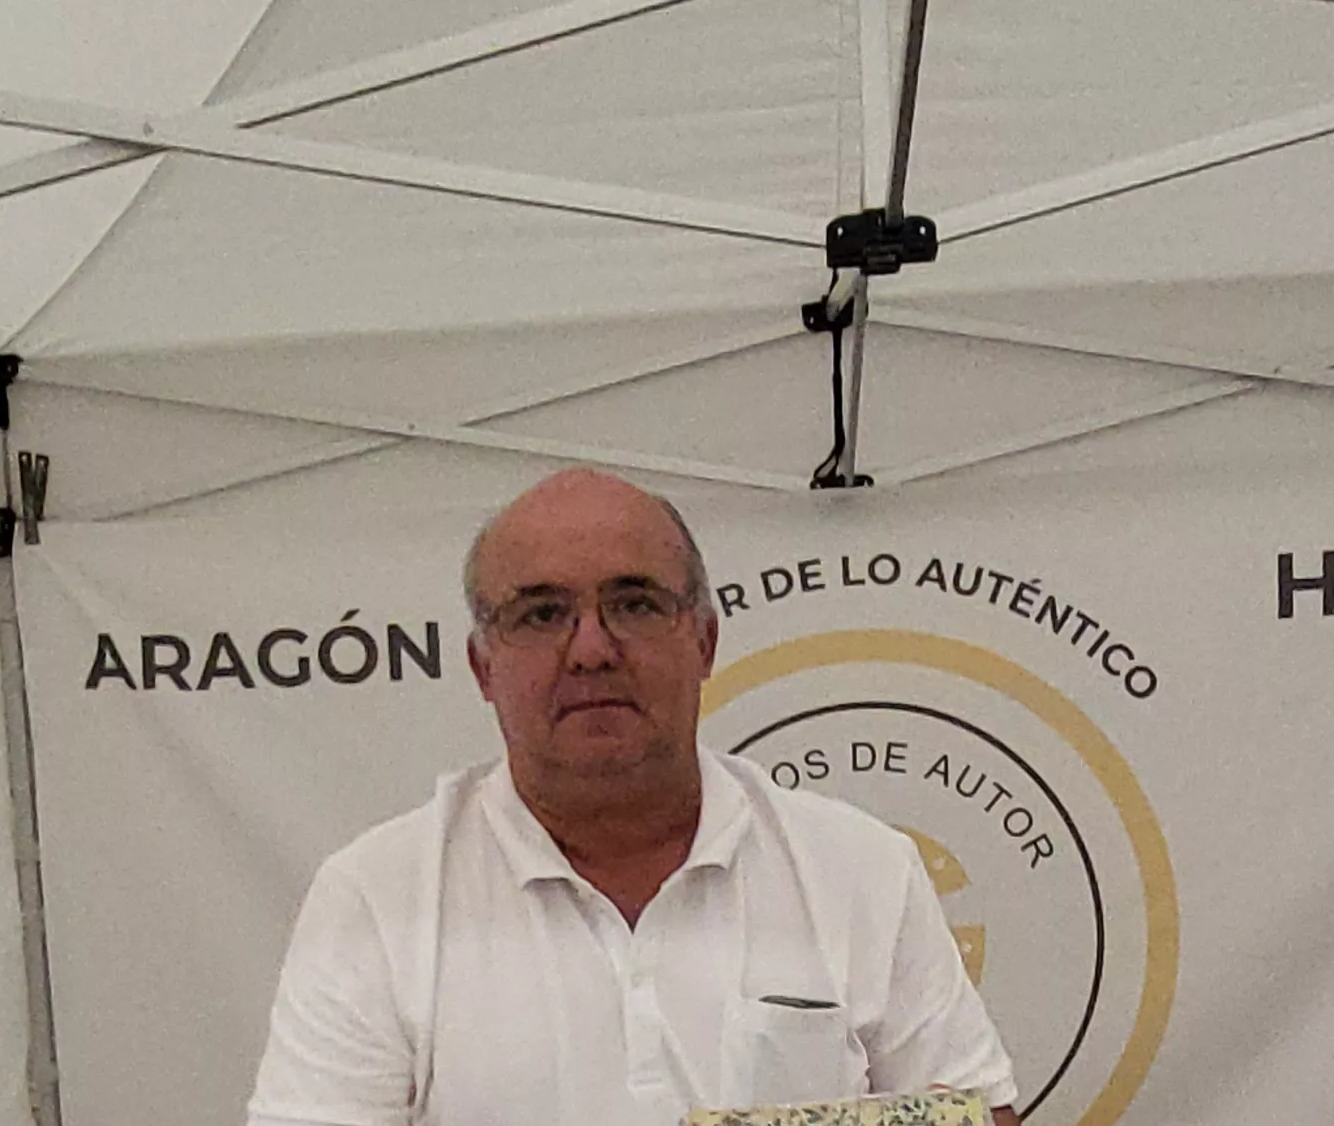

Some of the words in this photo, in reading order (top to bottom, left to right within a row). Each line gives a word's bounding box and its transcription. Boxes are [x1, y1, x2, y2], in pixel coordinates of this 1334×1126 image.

[84, 609, 442, 691] ARAGÓN
[760, 558, 826, 602] DE
[841, 552, 901, 587] LO
[914, 556, 1158, 700] AUTÉNTICO
[850, 741, 909, 774] DE
[923, 753, 1055, 869] AUTOR
